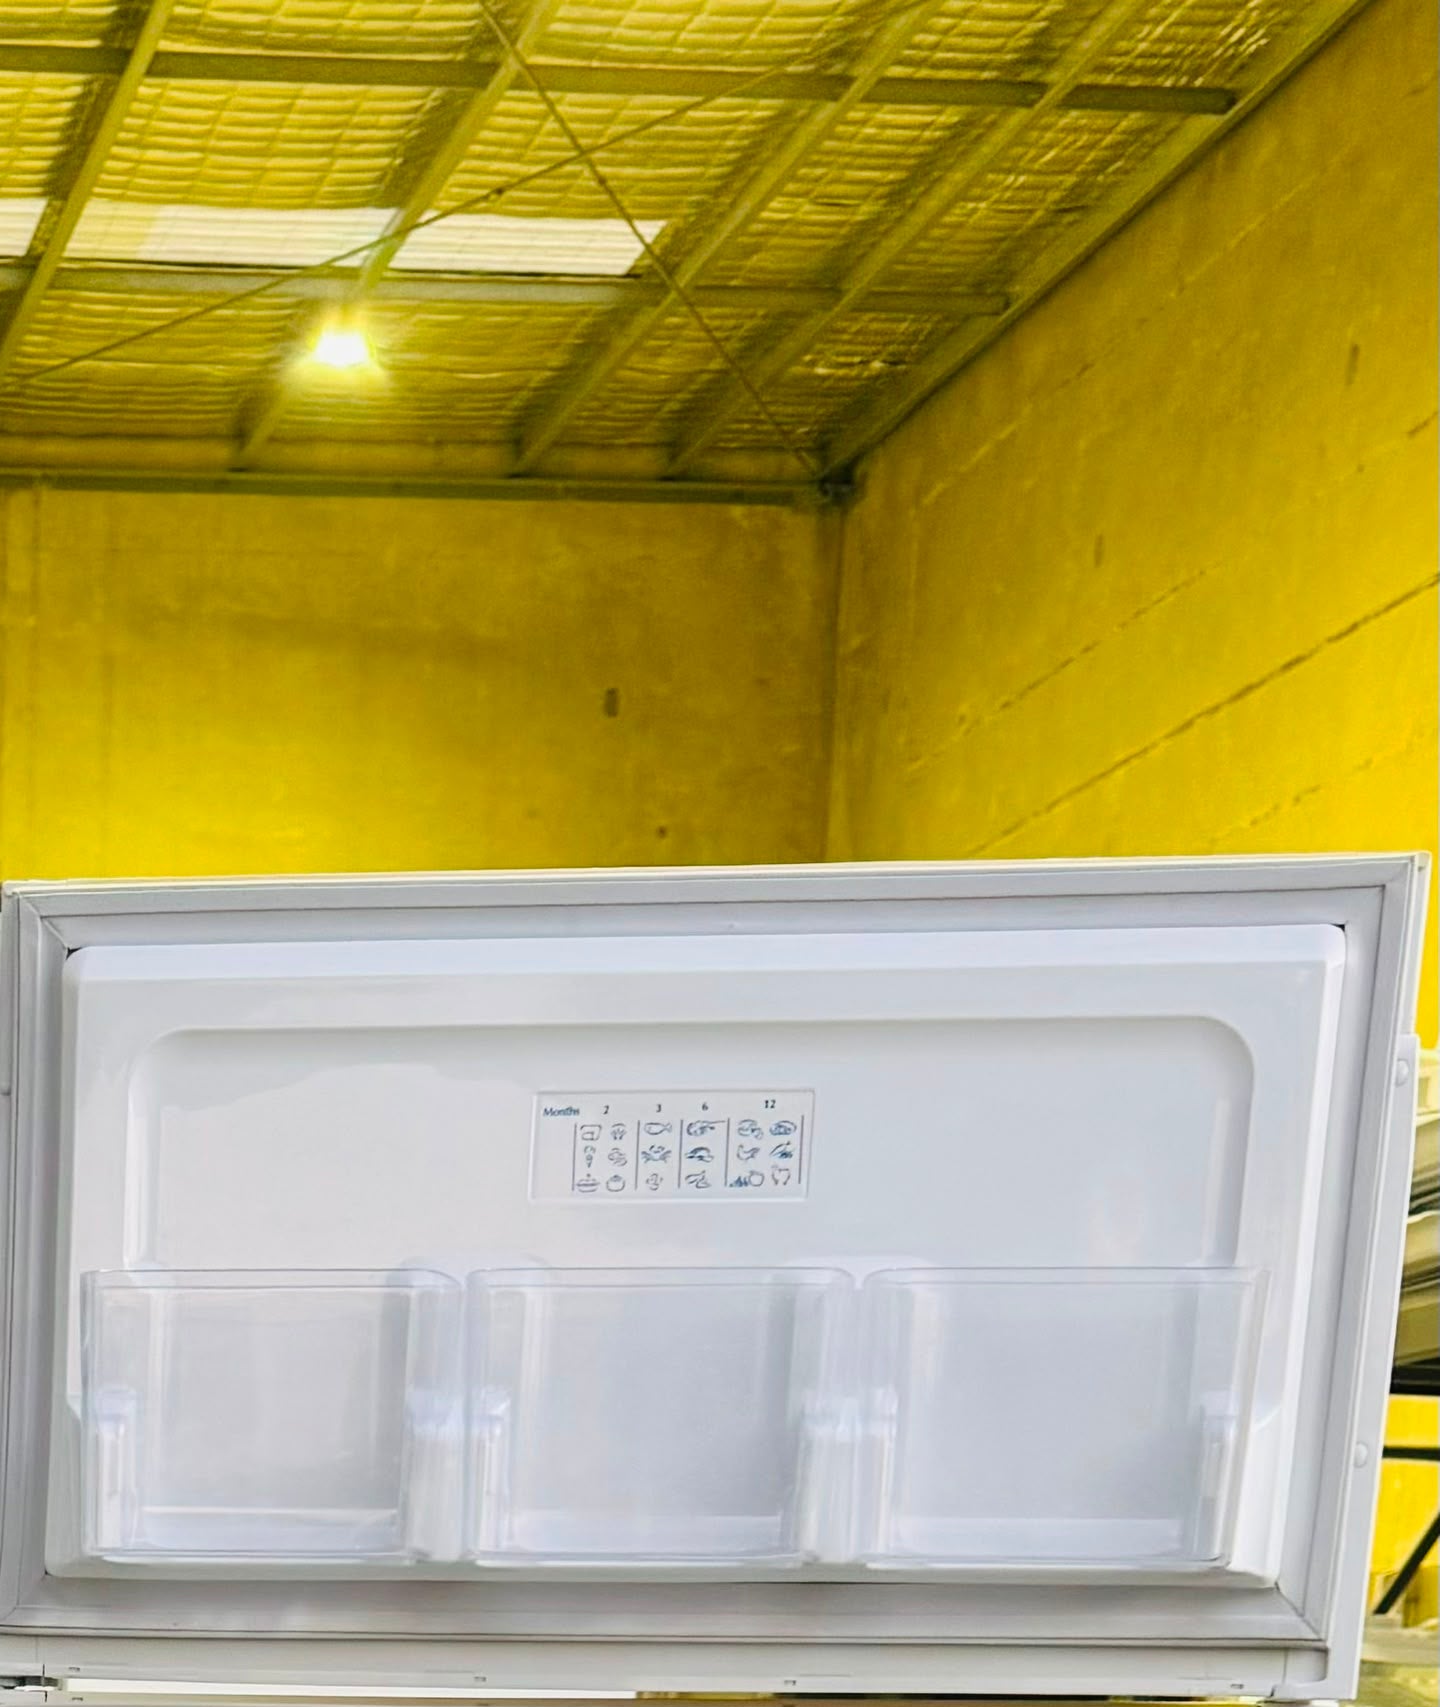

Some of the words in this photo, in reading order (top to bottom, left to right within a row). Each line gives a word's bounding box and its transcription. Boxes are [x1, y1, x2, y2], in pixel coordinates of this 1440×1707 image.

[543, 1106, 580, 1117] Months
[702, 1101, 709, 1111] 6
[764, 1099, 776, 1109] 12
